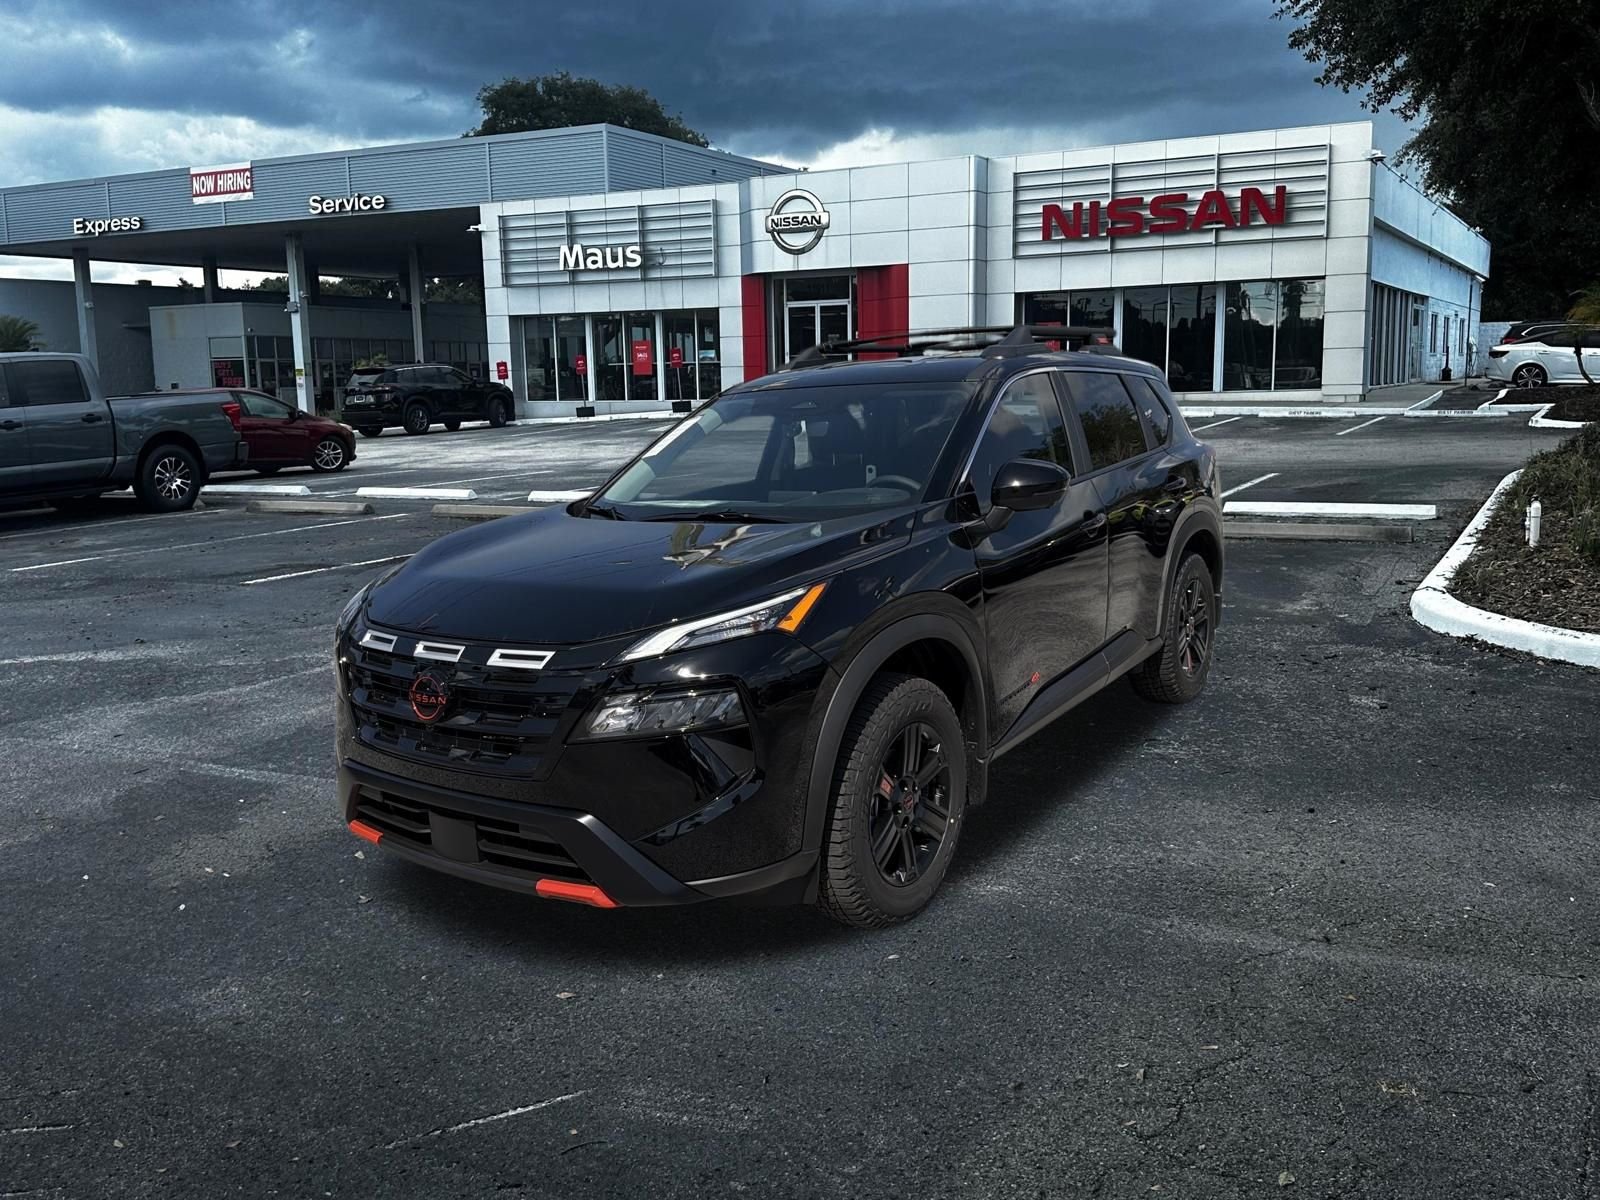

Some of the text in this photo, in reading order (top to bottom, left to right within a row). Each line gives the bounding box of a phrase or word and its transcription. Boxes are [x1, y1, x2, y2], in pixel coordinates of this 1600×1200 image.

[192, 171, 251, 195] NOW HIRING
[308, 193, 385, 214] Service
[1041, 185, 1287, 241] NISSAN
[72, 216, 141, 237] Express
[769, 213, 823, 229] NISSAN
[558, 242, 642, 271] Maus
[223, 376, 244, 386] FREE
